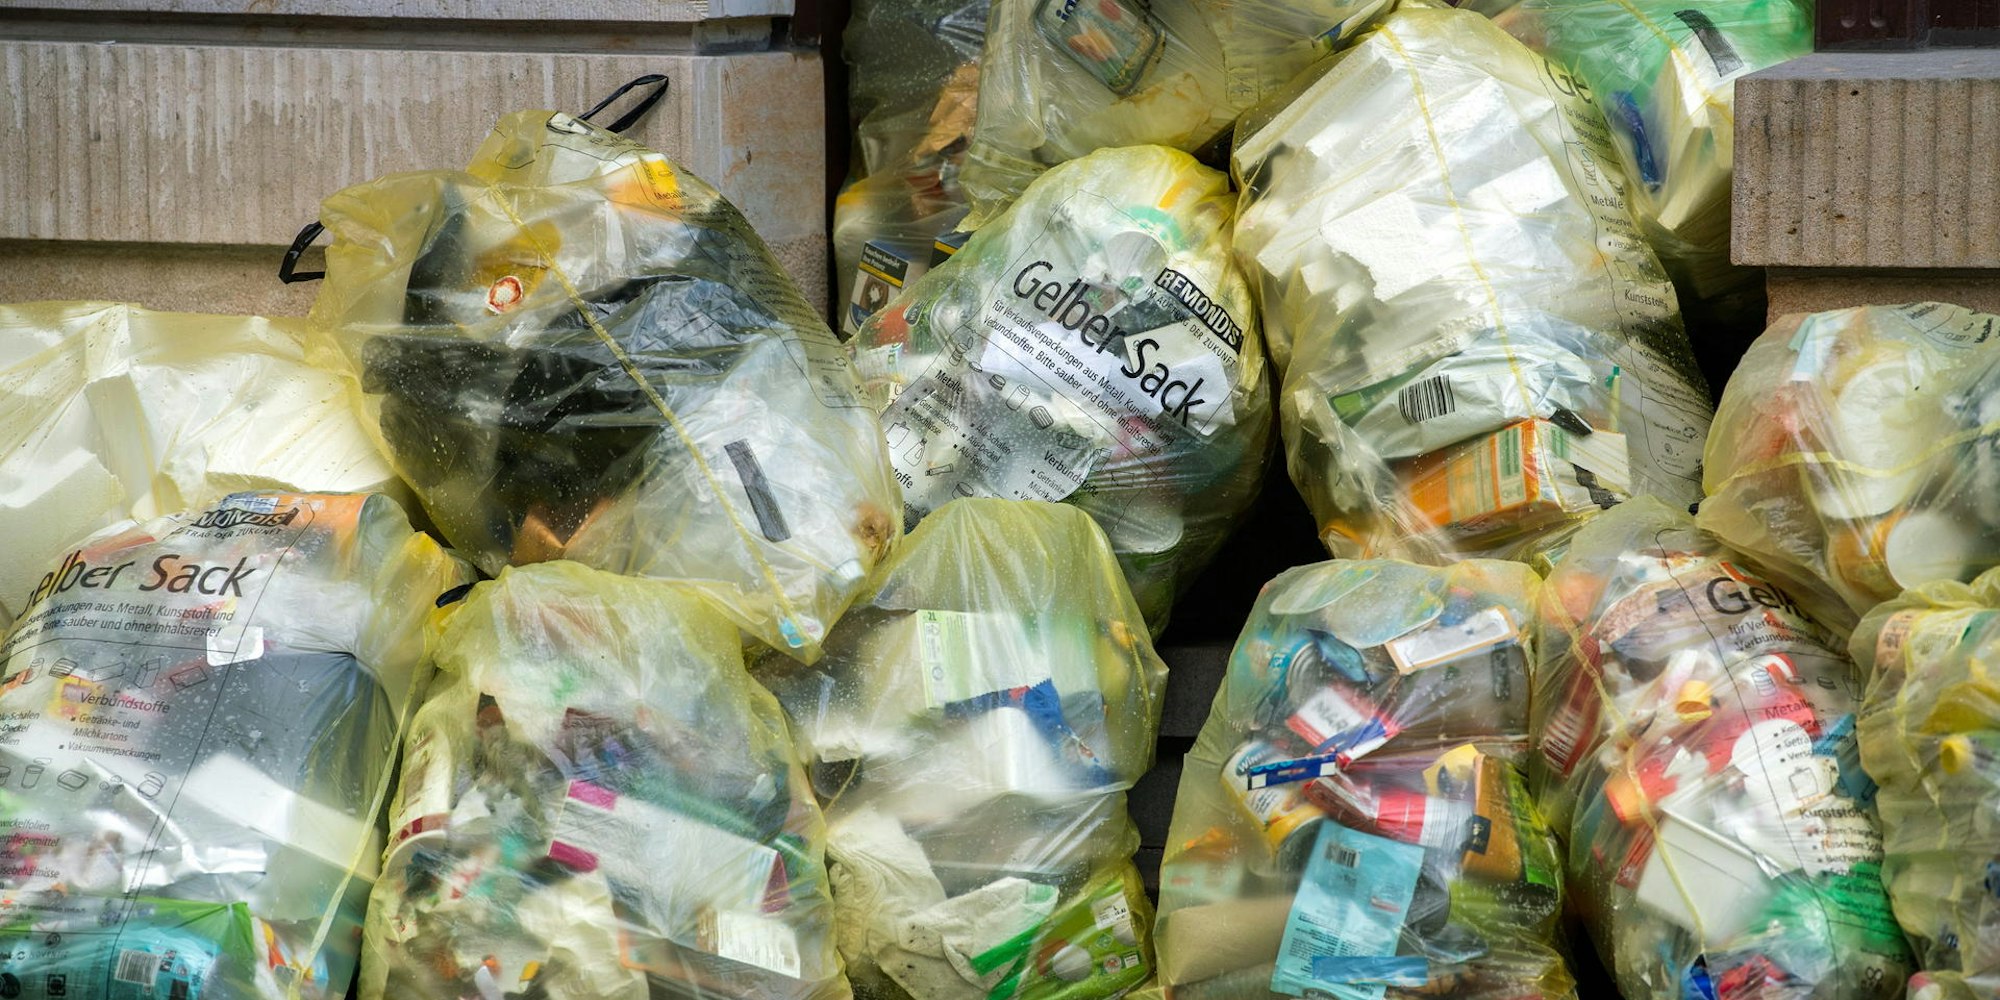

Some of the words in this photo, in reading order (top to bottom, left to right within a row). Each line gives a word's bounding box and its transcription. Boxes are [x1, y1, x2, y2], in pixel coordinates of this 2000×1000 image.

[1155, 267, 1244, 355] REMONDIS
[1145, 286, 1157, 299] IM
[1157, 297, 1189, 327] AUFTRAG
[1189, 323, 1204, 340] DER
[1202, 337, 1237, 367] ZUKUNFT
[1013, 260, 1127, 354] Gelber
[1120, 338, 1206, 427] Sack
[935, 369, 963, 395] Metalle
[992, 299, 1004, 310] für
[1003, 305, 1084, 370] Verkaufsverpackungen
[1082, 366, 1099, 381] aus
[1098, 376, 1125, 404] Metall,
[1124, 398, 1161, 432] Kunststoff
[1158, 431, 1176, 446] und
[1035, 350, 1057, 371] Bitte
[1057, 365, 1083, 390] sauber
[1081, 387, 1099, 403] und
[1097, 398, 1119, 420] ohne
[967, 434, 1001, 462] Alu-Deckel
[975, 423, 1012, 455] Alu-Schalen
[958, 445, 990, 473] Alu-Folien
[1044, 450, 1099, 497] Verbundstoffe
[236, 527, 282, 537] ZUKUNFT
[139, 553, 257, 598] Sack
[95, 601, 114, 613] aus
[117, 602, 153, 616] Metall,
[156, 605, 213, 619] Kunststoff
[213, 610, 236, 621] und
[63, 616, 99, 628] sauber
[100, 619, 125, 631] und
[124, 620, 152, 633] ohne
[153, 623, 222, 638] Inhaltsreste!
[1728, 623, 1746, 636] für
[80, 692, 170, 714] Verbundstoffe
[73, 728, 129, 743] Milchkartons
[122, 715, 141, 730] und
[67, 742, 161, 762] Vakuumverpackungen
